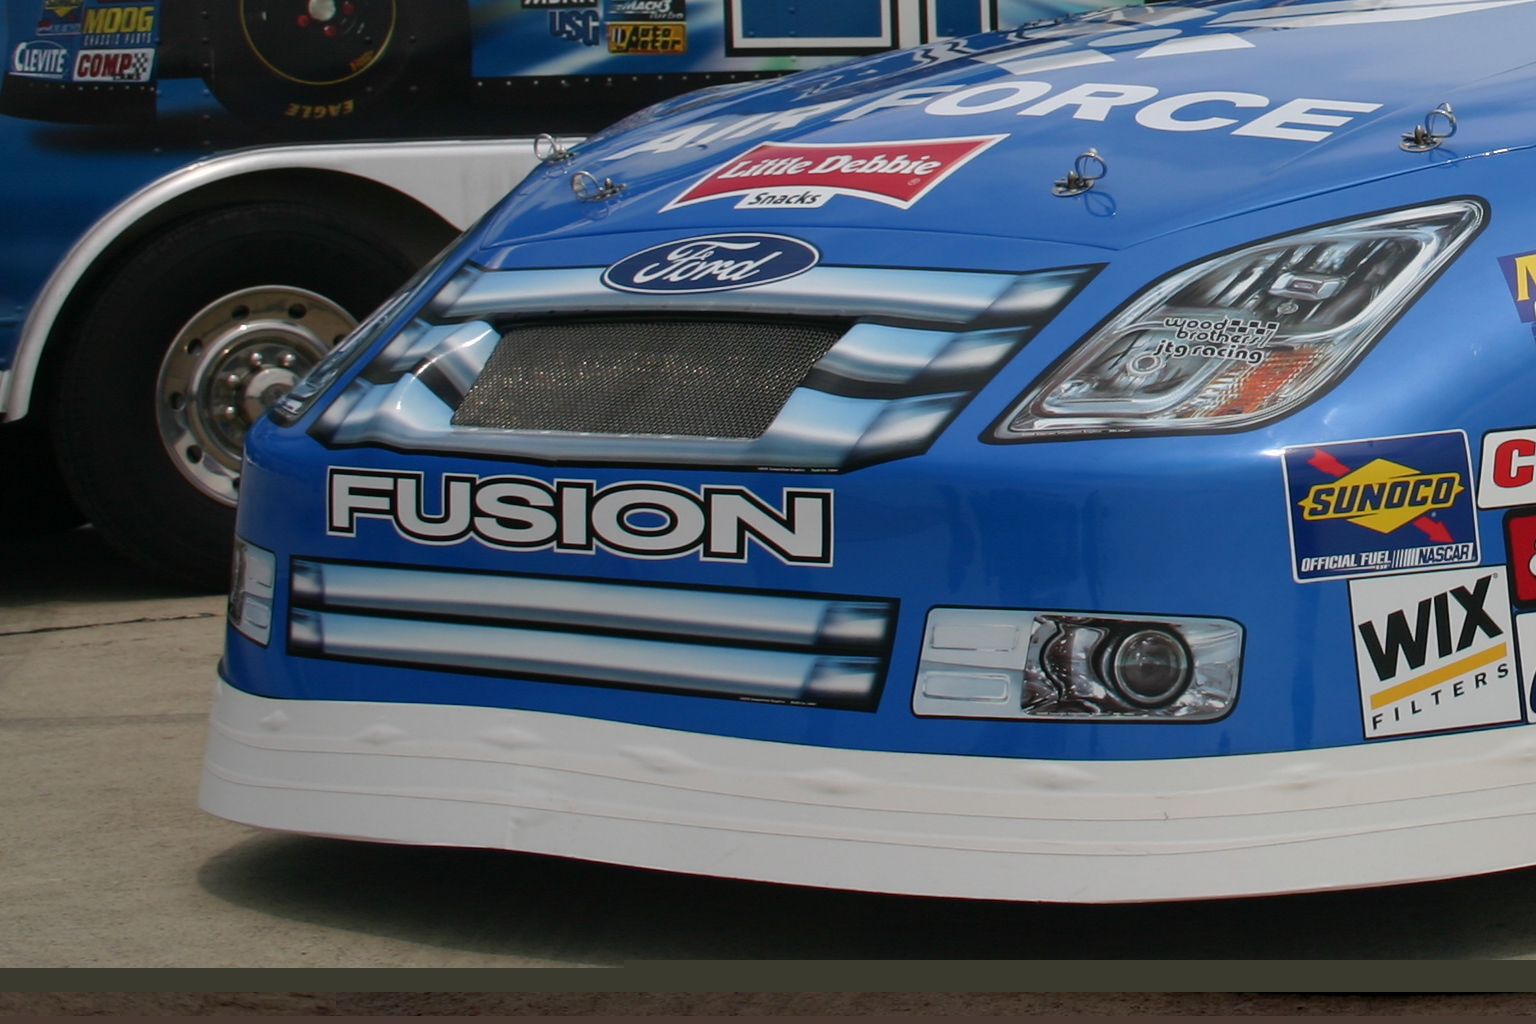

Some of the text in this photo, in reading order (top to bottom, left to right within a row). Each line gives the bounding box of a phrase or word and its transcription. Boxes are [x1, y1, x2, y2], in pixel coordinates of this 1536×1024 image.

[83, 6, 155, 34] MOOG
[549, 9, 600, 47] USG
[14, 42, 68, 73] CLEVITE
[76, 53, 133, 78] COMP
[600, 79, 1385, 162] AIR FORCE
[716, 153, 943, 180] Little Debbie
[747, 190, 822, 207] Snacks
[632, 239, 784, 285] Ford
[1165, 316, 1229, 331] wood
[1176, 327, 1260, 345] brothers
[1153, 339, 1264, 365] jtg racing
[1306, 476, 1460, 521] SUNOCO
[326, 465, 835, 567] FUSION
[1301, 543, 1471, 573] OFFICIAL FUEL NASCAR
[1358, 574, 1504, 682] WIX
[1371, 661, 1510, 731] FILTERS
